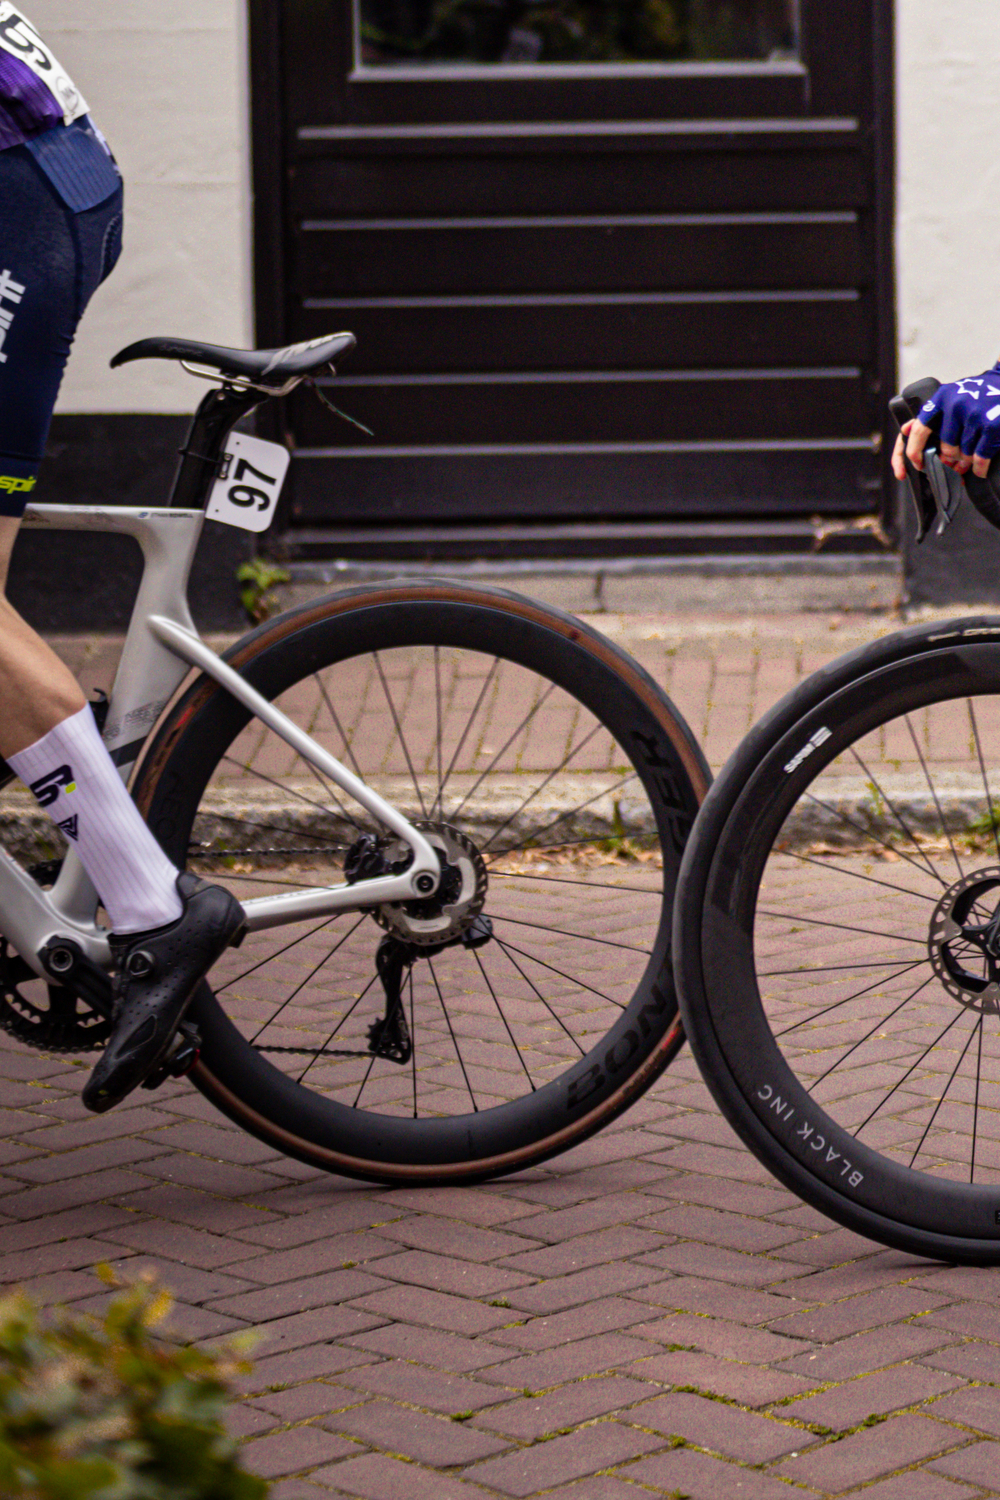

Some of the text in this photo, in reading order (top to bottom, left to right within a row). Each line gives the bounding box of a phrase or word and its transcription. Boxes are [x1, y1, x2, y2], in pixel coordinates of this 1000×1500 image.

[227, 458, 277, 512] 97
[757, 1084, 864, 1188] BLACK INC
